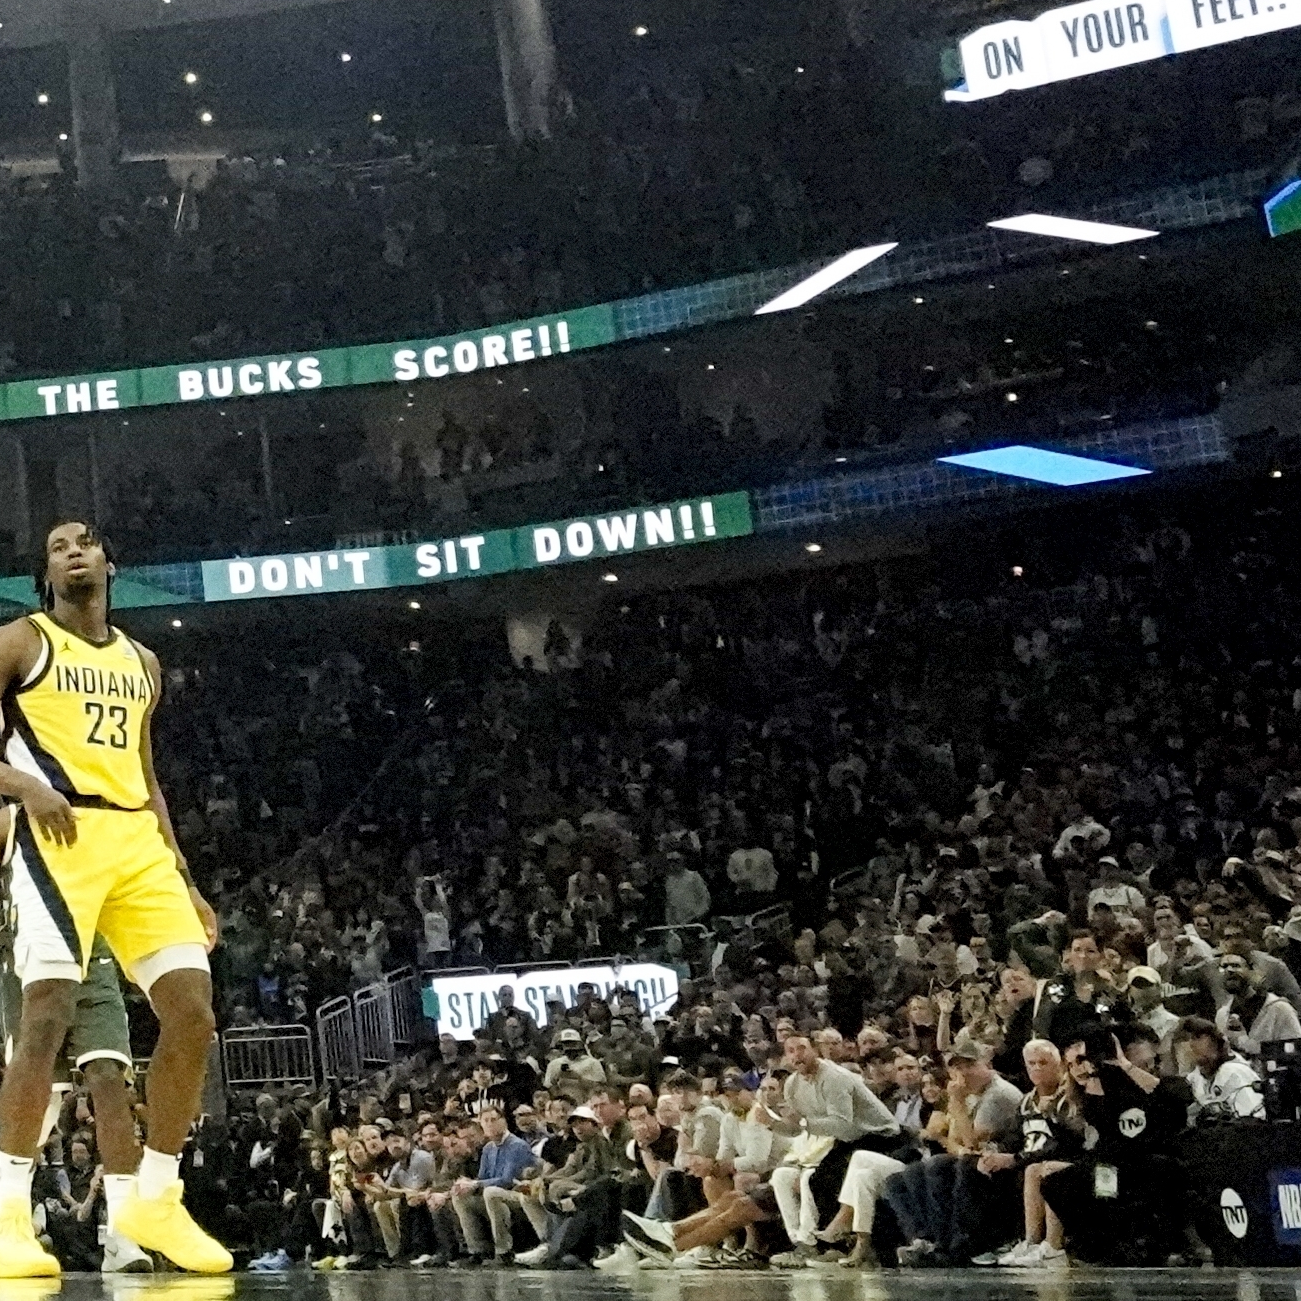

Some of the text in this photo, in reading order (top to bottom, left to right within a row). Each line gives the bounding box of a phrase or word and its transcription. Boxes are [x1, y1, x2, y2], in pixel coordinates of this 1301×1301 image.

[982, 36, 1025, 80] ON
[1060, 2, 1150, 59] YOUR
[37, 379, 120, 416] THE
[177, 357, 323, 400] BUCKS
[393, 321, 571, 381] SCORE!!
[228, 501, 716, 594] DON'T SIT DOWN!!
[56, 665, 147, 705] INDIANA
[85, 702, 128, 750] 23
[1221, 1205, 1245, 1225] TNT
[1277, 1183, 1301, 1229] NB
